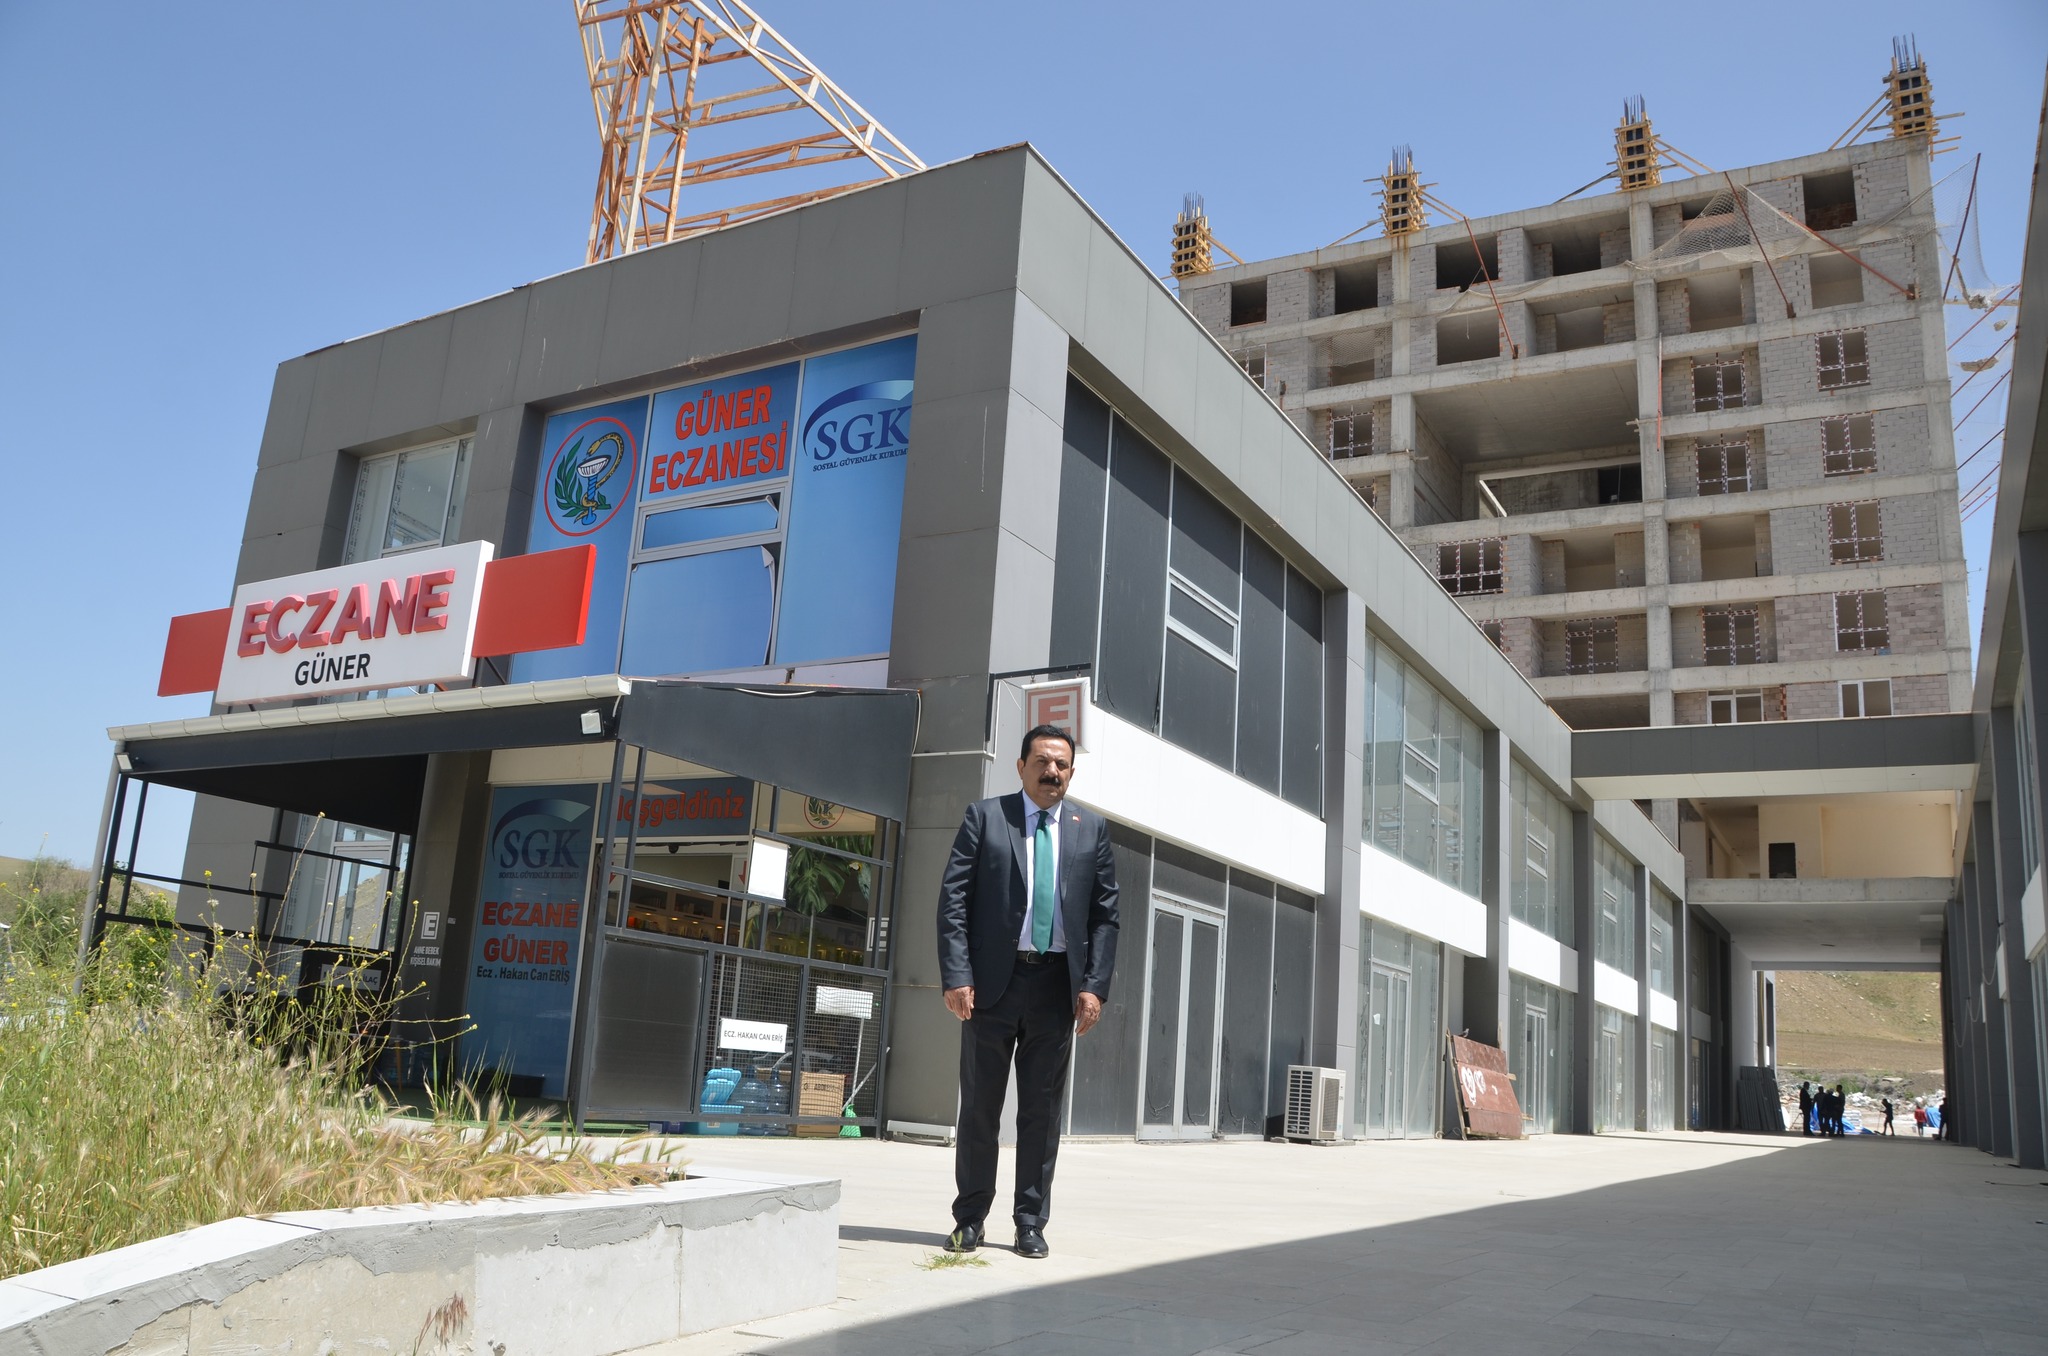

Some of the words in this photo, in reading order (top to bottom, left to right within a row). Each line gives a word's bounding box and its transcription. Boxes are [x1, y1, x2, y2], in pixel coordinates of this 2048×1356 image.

[675, 385, 772, 440] GÜNER
[814, 405, 912, 460] SGK
[649, 420, 787, 494] ECZANESİ
[813, 461, 838, 472] SOSYAL
[840, 453, 877, 467] GÜVENLİK
[879, 448, 908, 459] KURUM
[237, 568, 455, 658] ECZANE
[294, 652, 371, 686] GÜNER
[1038, 695, 1071, 736] E
[500, 829, 581, 869] SGK
[424, 915, 437, 936] E
[482, 901, 579, 928] ECZANE
[483, 933, 569, 966] GÜNER
[500, 967, 528, 980] Hakan
[530, 968, 549, 981] Can
[549, 967, 570, 986] ERİŞ
[724, 1030, 737, 1038] ECZ.
[738, 1032, 758, 1040] HAKAN
[758, 1033, 771, 1041] CAN
[771, 1034, 783, 1043] ERİŞ
